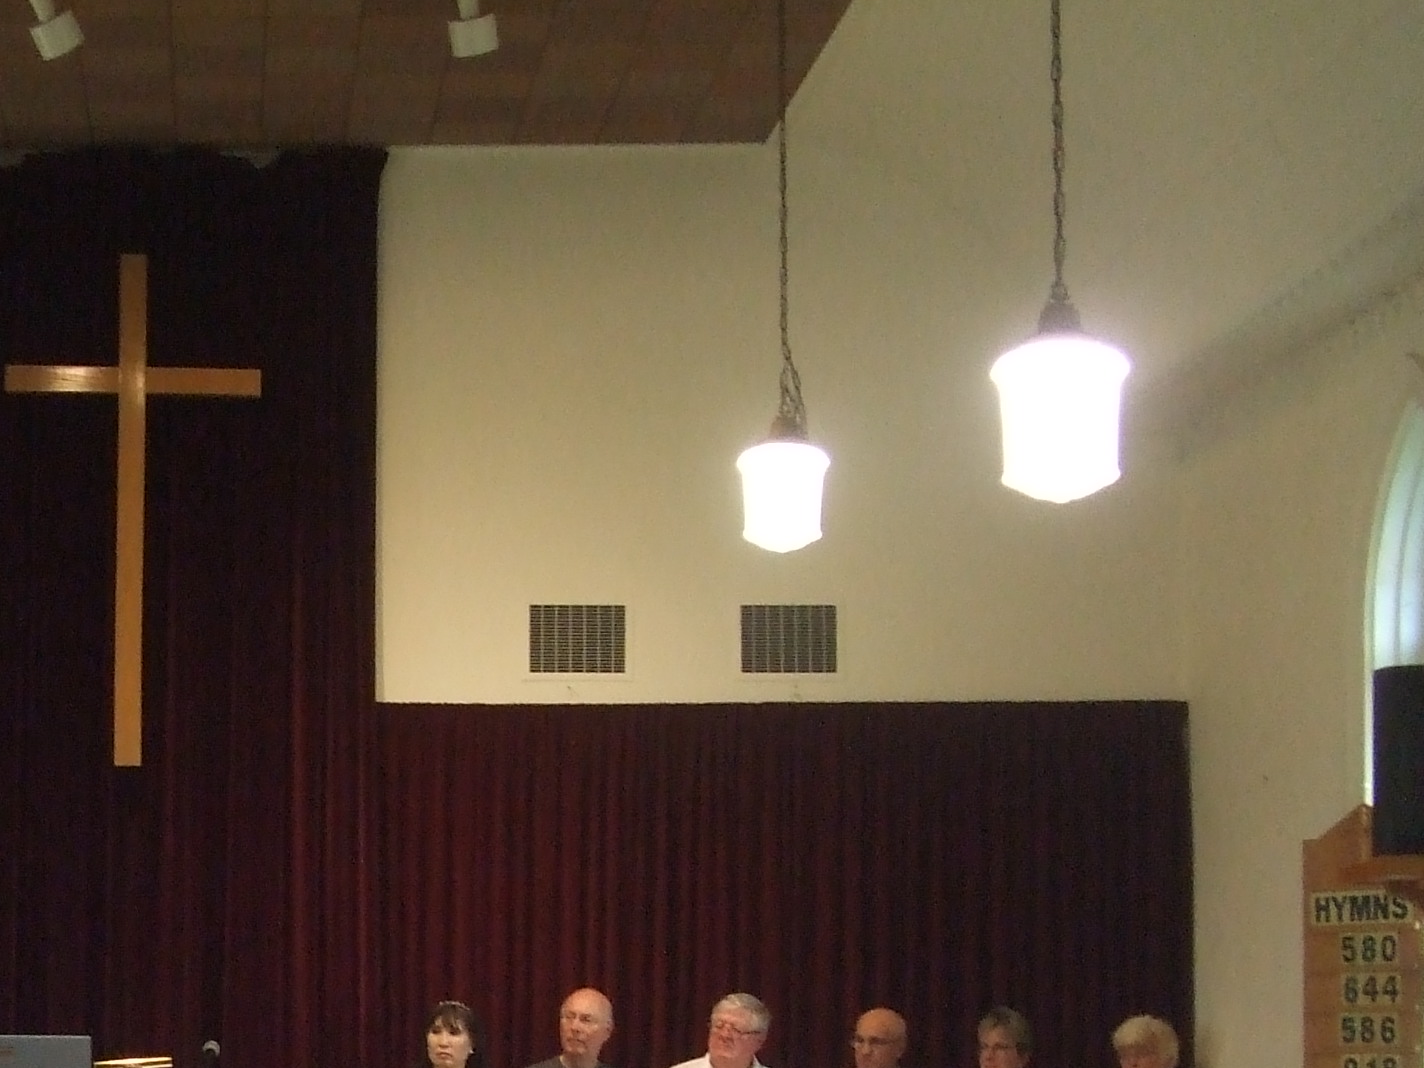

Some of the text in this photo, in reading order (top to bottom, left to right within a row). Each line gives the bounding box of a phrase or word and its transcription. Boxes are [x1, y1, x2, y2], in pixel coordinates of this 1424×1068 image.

[1314, 894, 1409, 923] HYMNS
[1341, 934, 1397, 963] 580
[1344, 975, 1399, 1003] 644
[1341, 1015, 1396, 1044] 586
